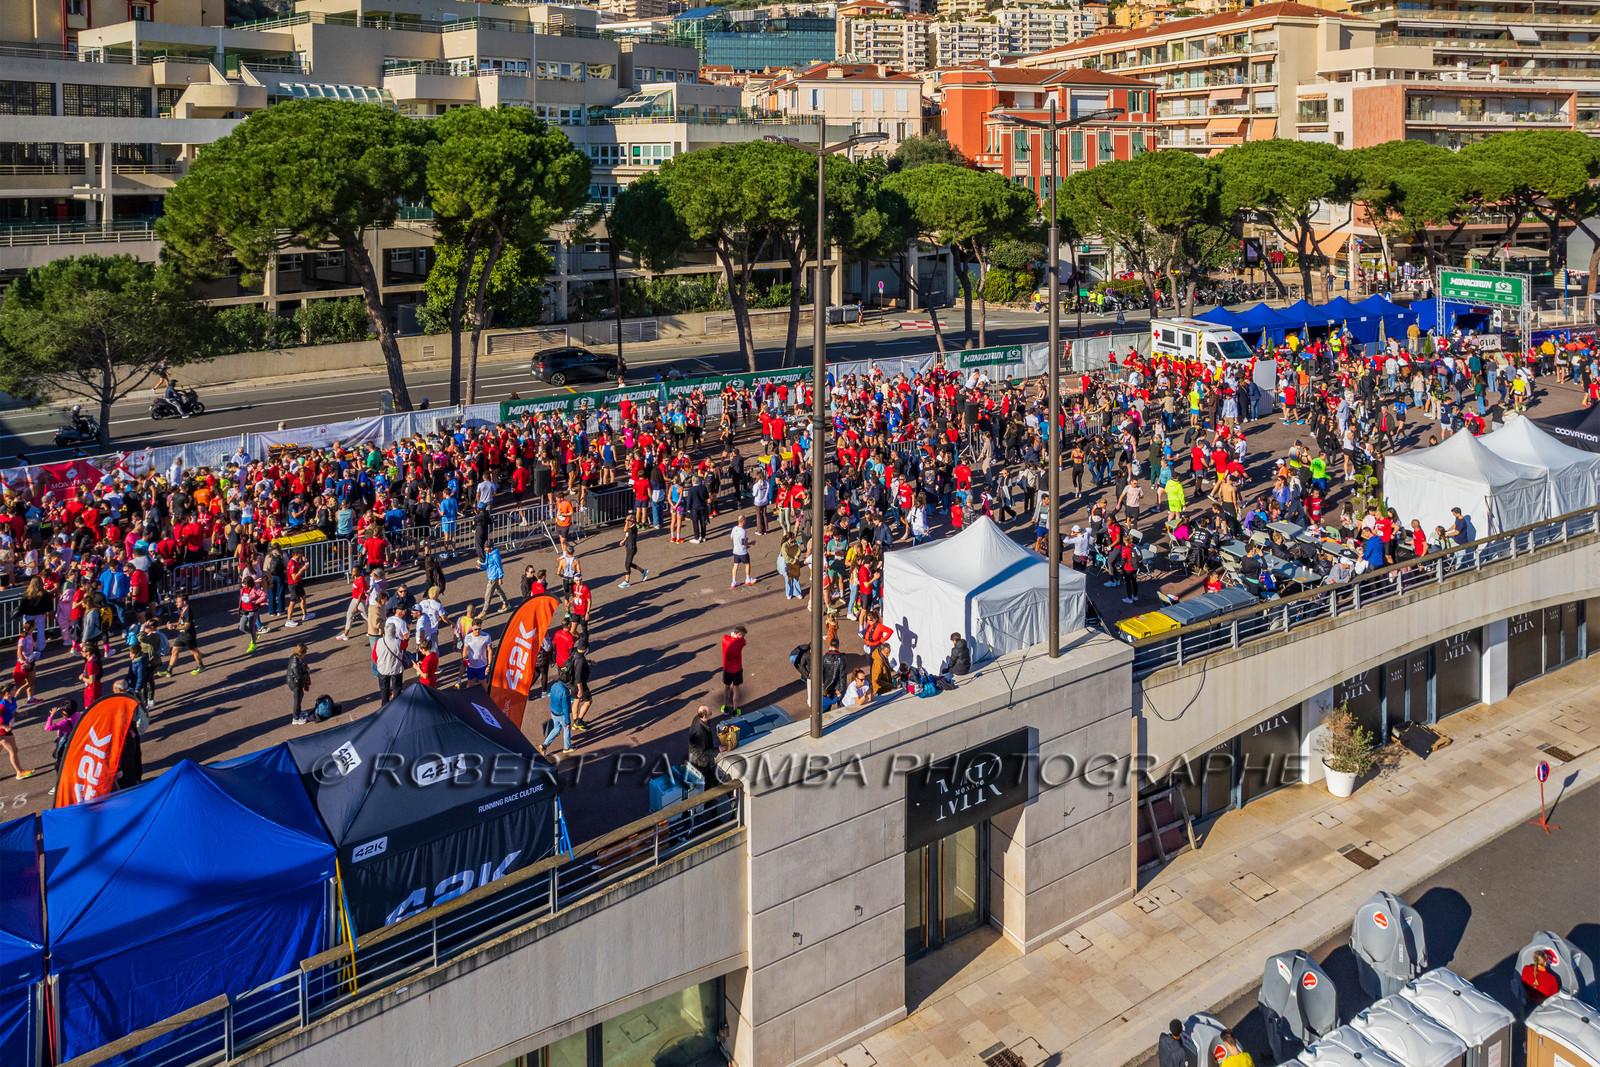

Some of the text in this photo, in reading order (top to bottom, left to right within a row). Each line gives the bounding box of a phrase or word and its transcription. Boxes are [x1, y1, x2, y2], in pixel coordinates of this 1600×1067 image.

[963, 351, 1004, 363] MONACORUN
[751, 373, 802, 387] MONCORUN
[507, 400, 569, 416] MONACORUN
[51, 477, 93, 489] MONAFRAIS
[505, 621, 536, 690] 42K
[74, 726, 112, 803] 42K
[336, 747, 358, 772] 42K
[421, 757, 464, 780] 42K
[478, 783, 544, 813] RUNNING RACE CULTURE
[355, 840, 385, 857] 42K
[384, 849, 522, 926] 42K
